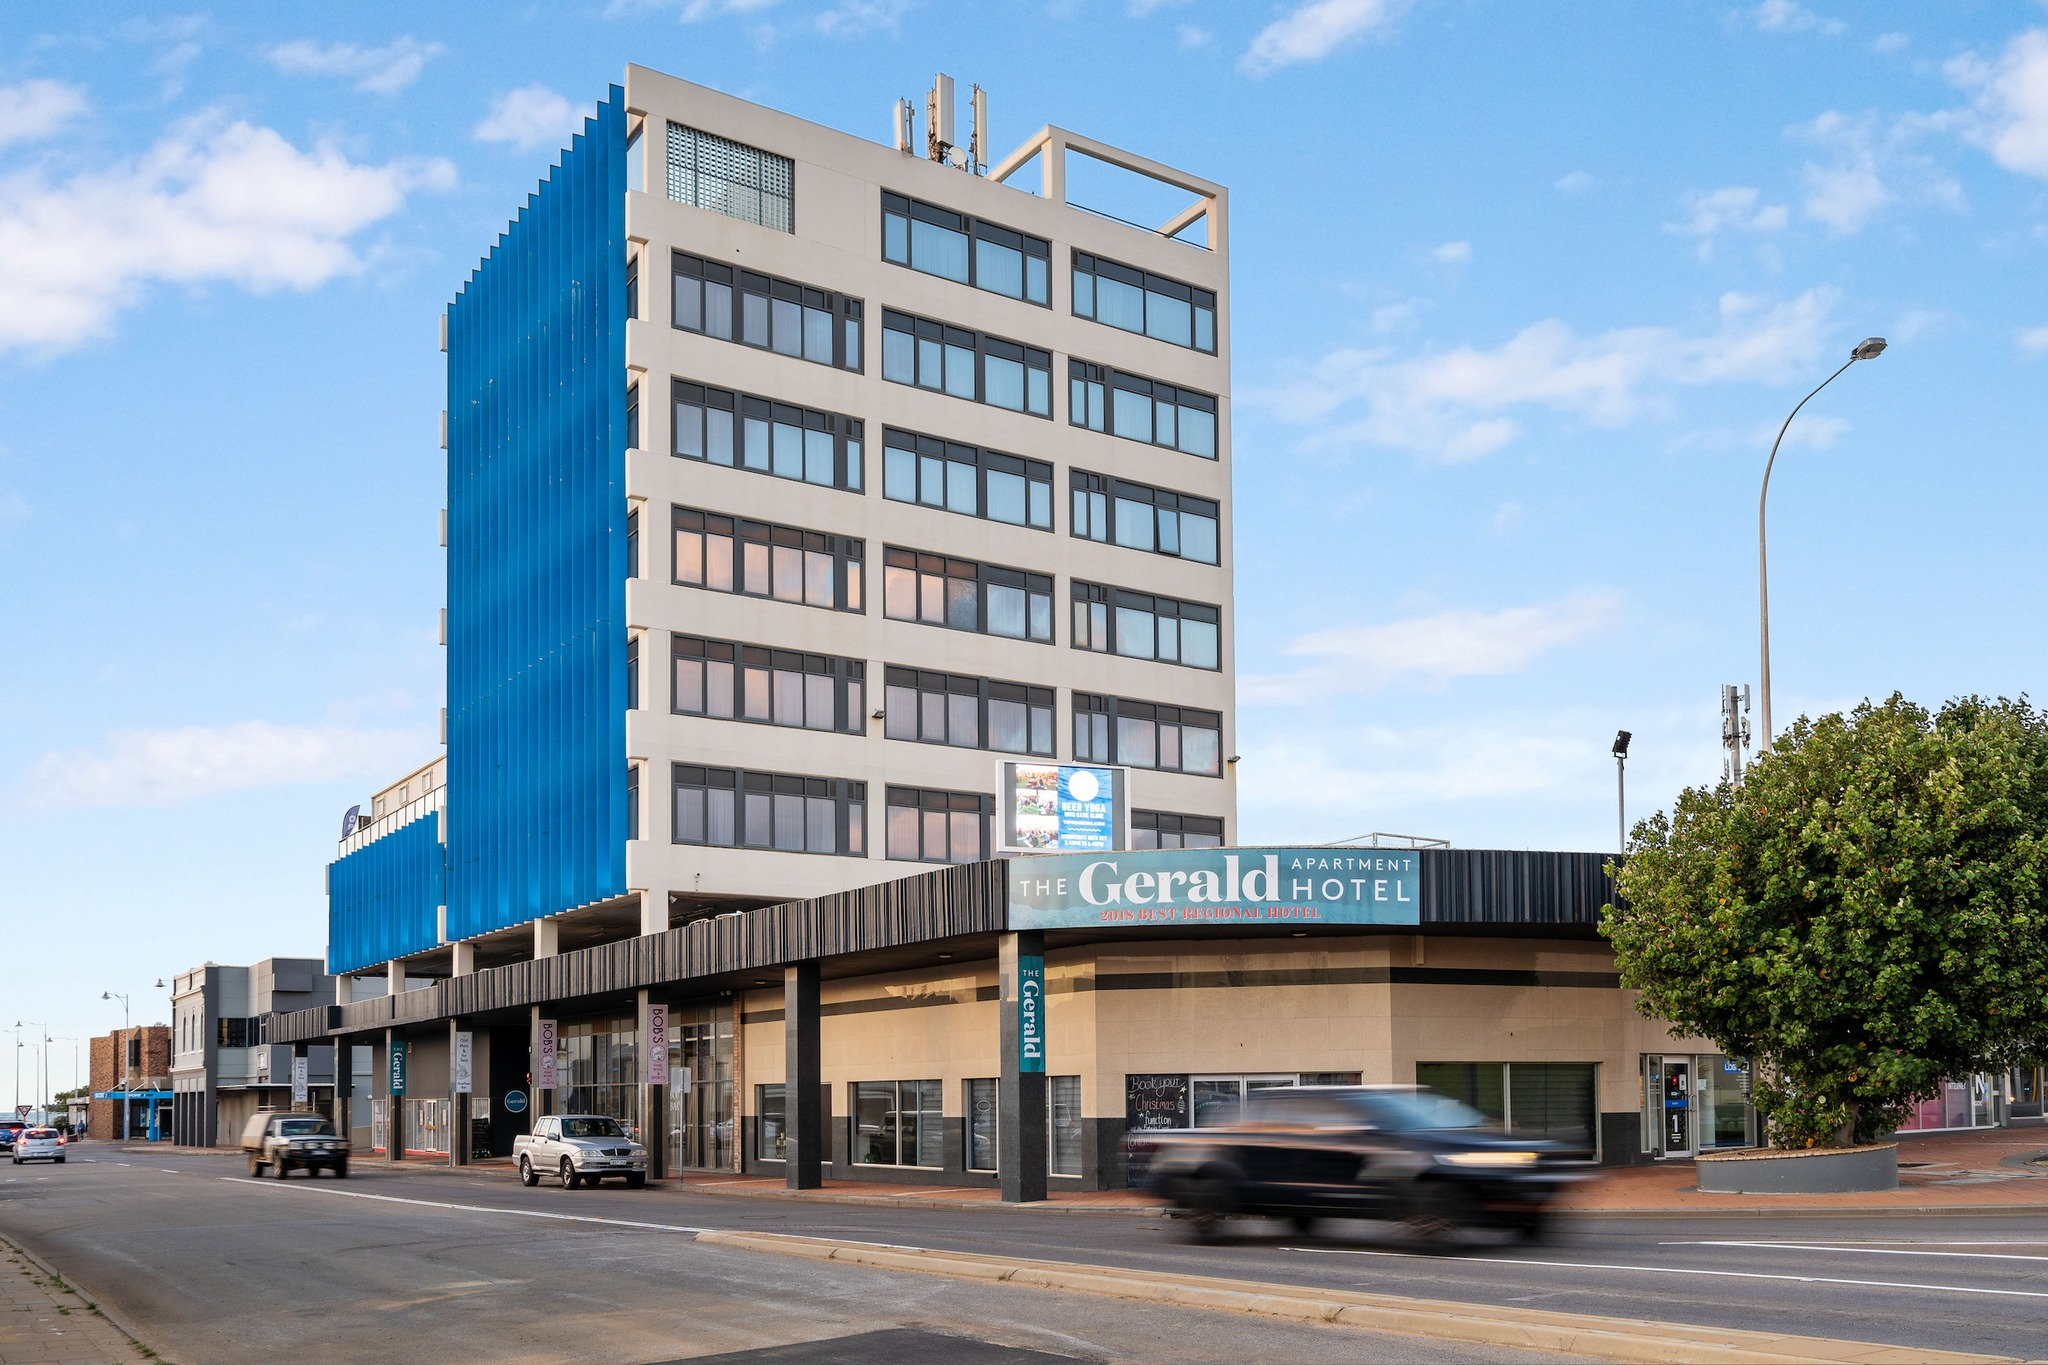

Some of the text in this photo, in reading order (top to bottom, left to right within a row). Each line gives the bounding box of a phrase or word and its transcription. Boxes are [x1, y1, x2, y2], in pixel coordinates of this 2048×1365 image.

[1084, 803, 1106, 813] YOGA
[1291, 858, 1411, 872] APARTMENT
[1020, 854, 1281, 906] THE Gerald
[1292, 878, 1411, 902] HOTEL
[1101, 906, 1321, 923] 2018 BEST REGIONAL HOTEL
[1023, 969, 1039, 977] THE
[653, 1008, 663, 1043] BOB'S
[1023, 980, 1041, 1058] Gerald
[543, 1023, 553, 1053] BOB'S
[393, 1052, 404, 1089] Gerald
[1130, 1076, 1183, 1097] Book your
[1135, 1093, 1175, 1111] Christmas
[1145, 1110, 1172, 1126] function
